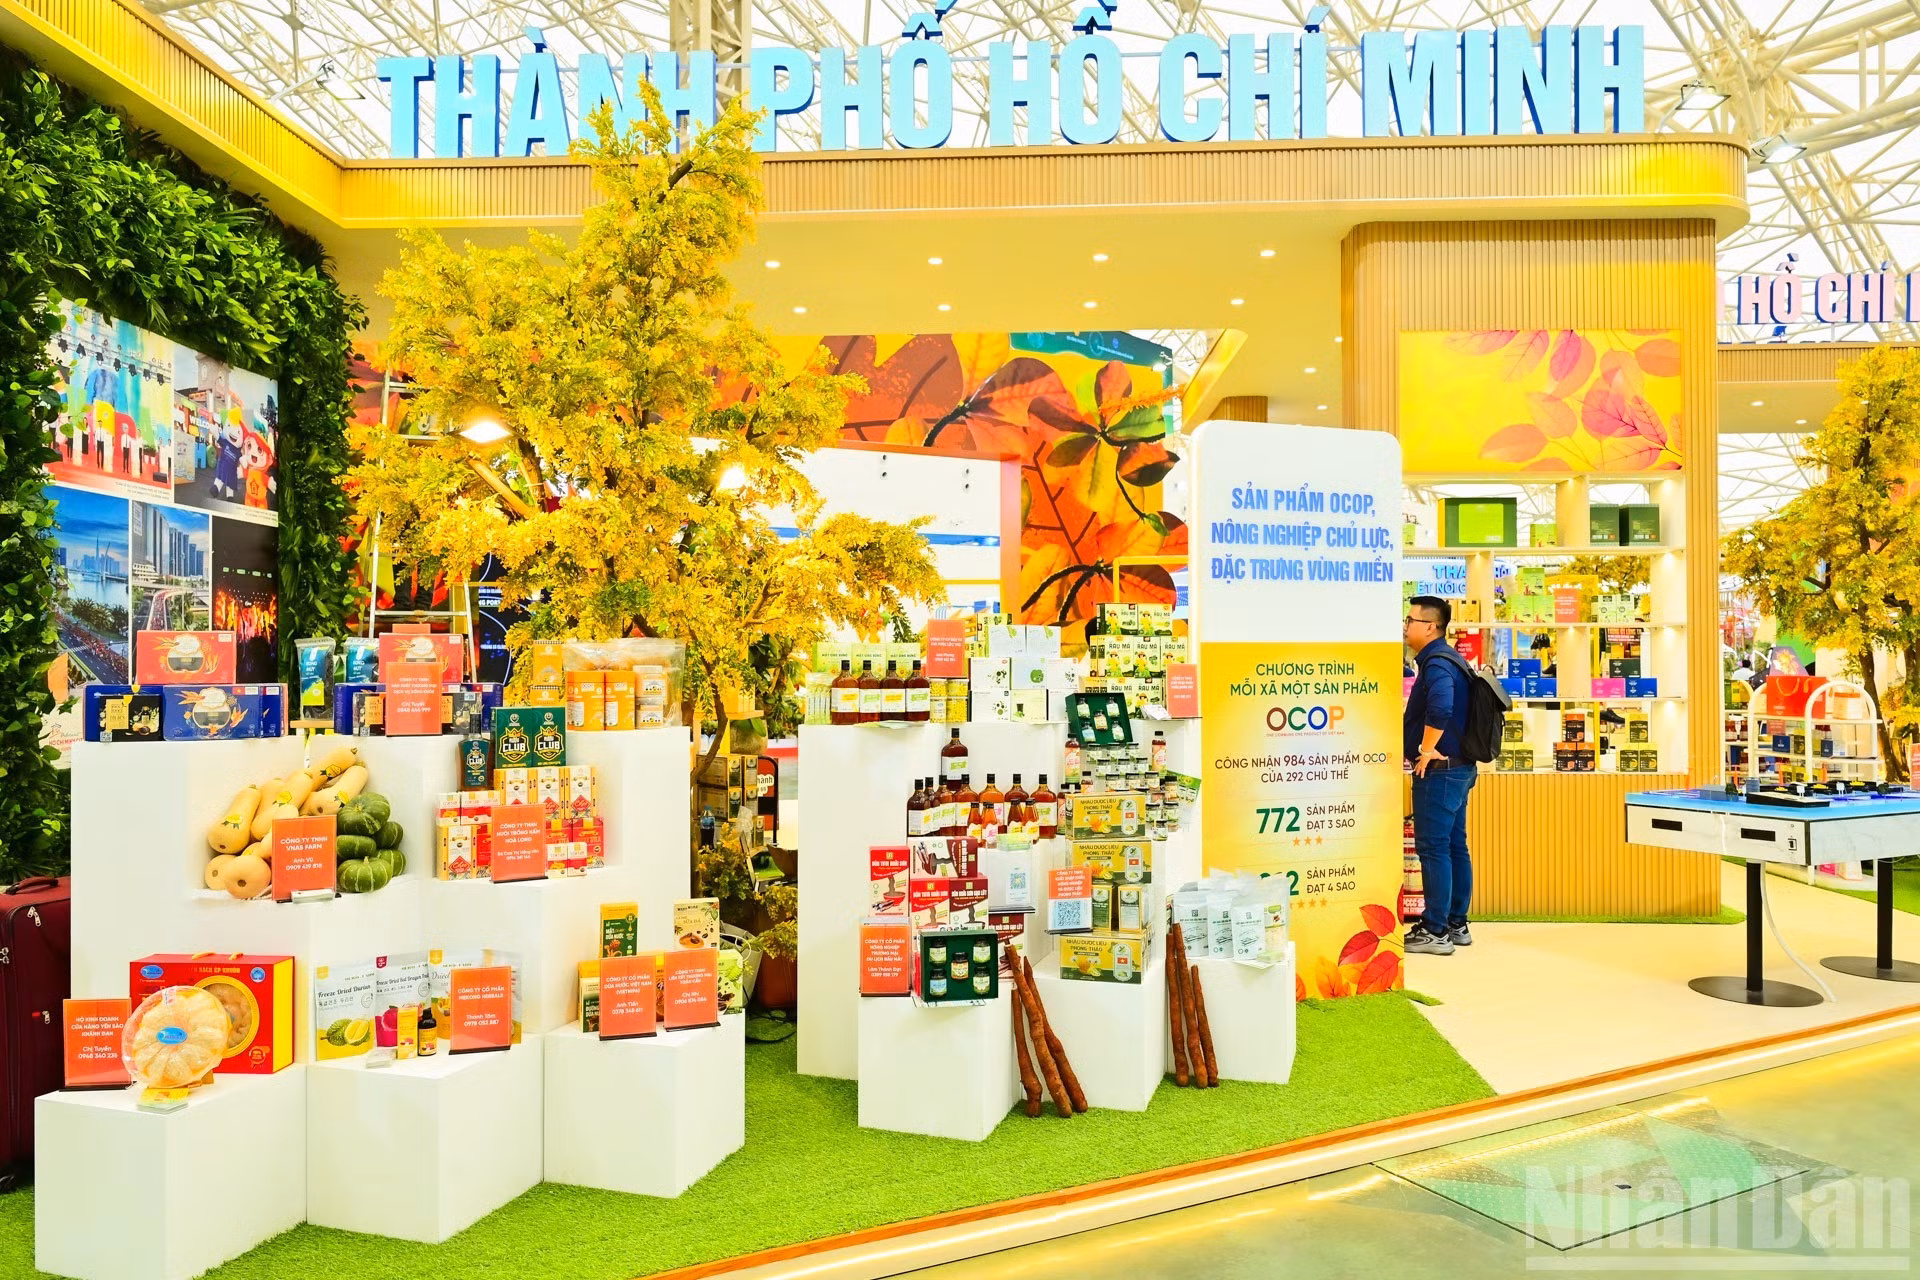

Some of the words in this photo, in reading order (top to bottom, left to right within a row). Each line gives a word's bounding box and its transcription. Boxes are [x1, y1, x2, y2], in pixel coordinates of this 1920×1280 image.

[376, 26, 717, 158] THÀNH
[750, 0, 957, 151] PHỐ
[1159, 5, 1330, 141] CHÍ
[1361, 24, 1644, 137] MINH
[1737, 253, 1802, 324] HỒ
[1815, 260, 1895, 323] CHÍ
[1232, 481, 1268, 510] SẢN
[1274, 483, 1324, 512] PHẨM
[1330, 493, 1376, 517] OCOP,
[1211, 518, 1258, 544] NÔNG
[1263, 522, 1321, 550] NGHIỆP
[1326, 521, 1357, 548] CHỦ
[1362, 527, 1394, 552] LỰC,
[1211, 554, 1245, 584] ĐẶC
[1250, 557, 1303, 580] TRƯNG
[1308, 556, 1349, 581] VÙNG
[1354, 555, 1393, 582] MIỀN
[1256, 662, 1314, 676] CHƯƠNG
[1318, 660, 1354, 675] TRÌNH
[1230, 678, 1256, 696] MỖI
[1260, 679, 1276, 696] XÃ
[1281, 680, 1310, 698] MỘT
[1314, 678, 1339, 695] SẢN
[1343, 677, 1378, 694] PHẨM
[1266, 706, 1344, 731] OCOP
[503, 743, 525, 752] CLUB
[538, 741, 560, 750] CLUB
[1215, 756, 1248, 769] CÔNG
[1252, 755, 1281, 770] NHẬN
[1284, 755, 1305, 767] 984
[1308, 753, 1329, 766] SẢN
[1332, 750, 1360, 765] PHẨM
[1363, 753, 1392, 763] OCOP
[1261, 769, 1283, 782] CỦA
[1286, 771, 1304, 781] 292
[1306, 768, 1326, 781] CHỦ
[1330, 765, 1349, 780] THỂ
[1306, 805, 1325, 815] SẢN
[1328, 803, 1355, 814] PHẨM
[1256, 807, 1300, 833] 772
[1307, 820, 1325, 832] ĐẠT
[1328, 820, 1333, 828] 3
[1336, 818, 1355, 828] SAO
[1306, 867, 1325, 879] SẢN
[1328, 864, 1355, 878] PHẨM
[1307, 884, 1325, 896] ĐẠT
[1327, 883, 1334, 891] 4
[1336, 881, 1356, 891] SAO
[318, 989, 335, 998] Freeze
[354, 984, 371, 992] Durian
